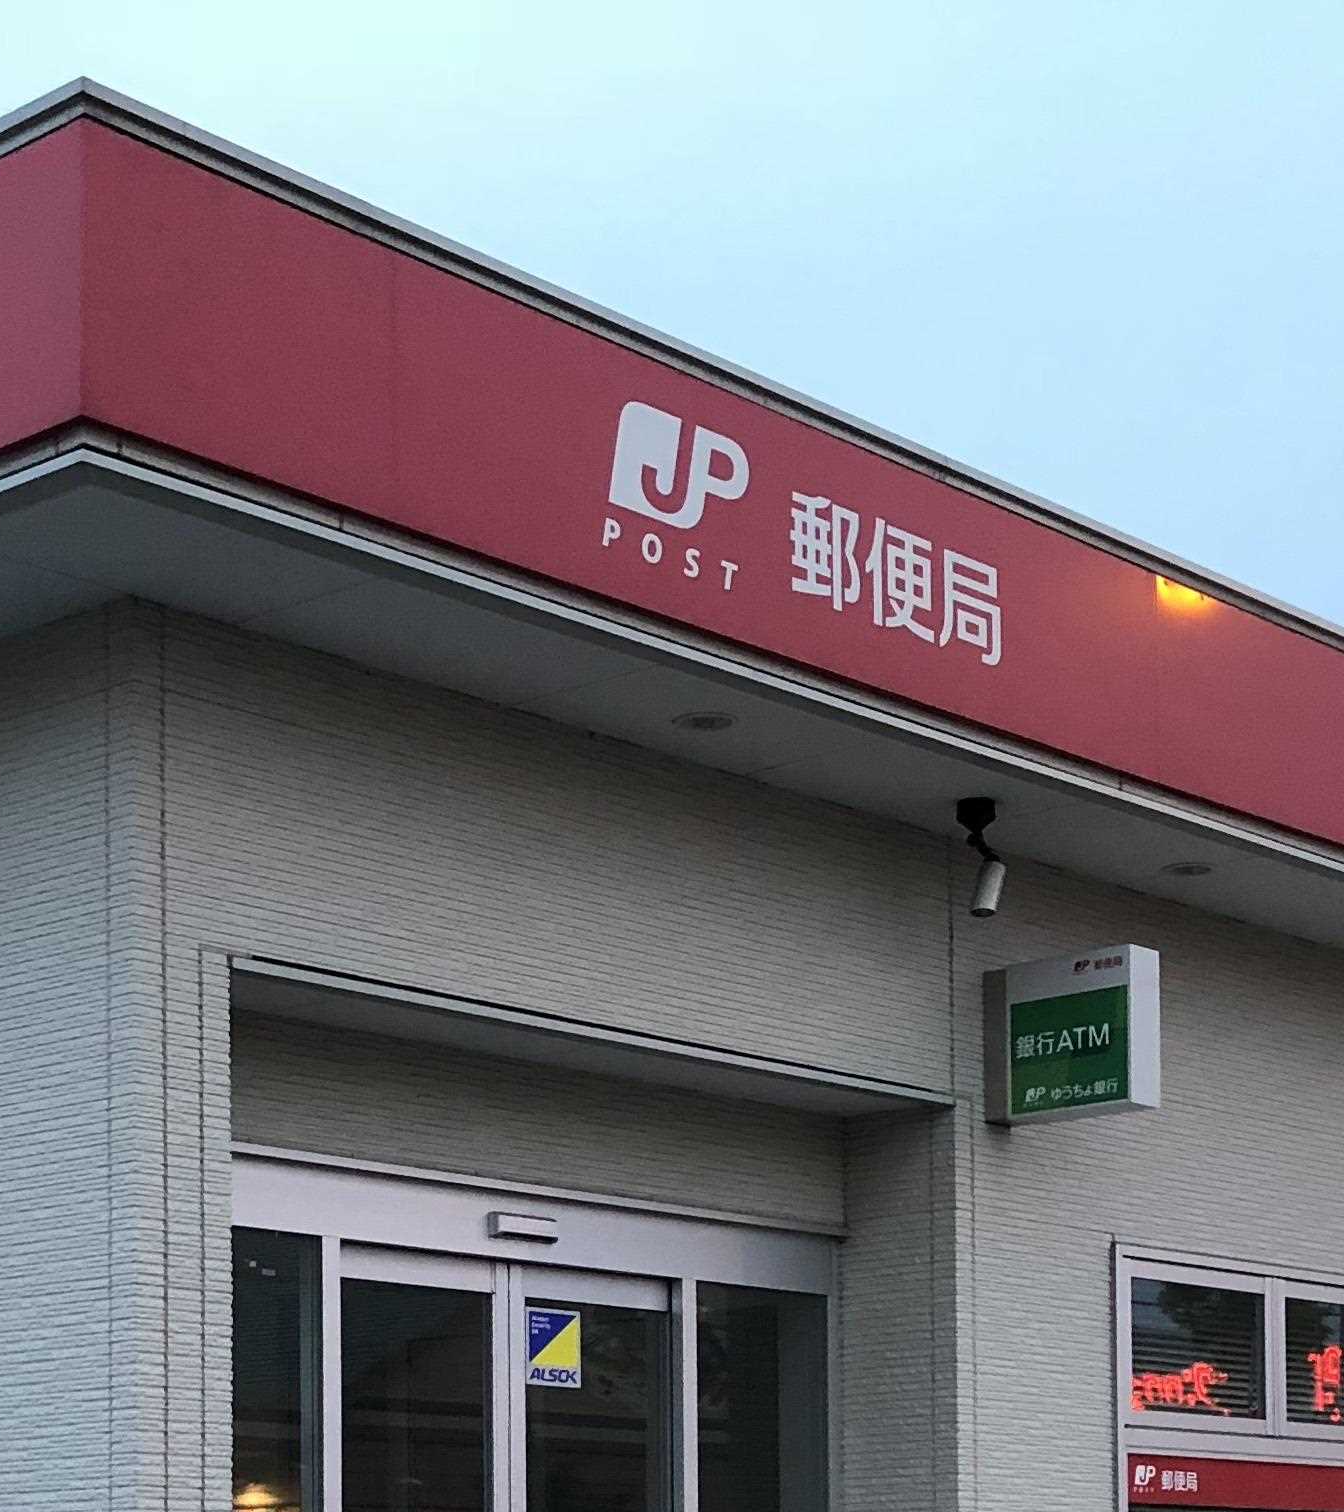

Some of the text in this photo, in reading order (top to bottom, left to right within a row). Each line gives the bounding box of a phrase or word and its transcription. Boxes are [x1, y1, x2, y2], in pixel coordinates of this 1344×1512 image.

[608, 401, 1002, 666] JP 郵便局
[602, 518, 739, 591] POST
[1015, 1022, 1110, 1059] 銀行ATM
[1051, 1078, 1118, 1100] ゆうちょ銀行
[1161, 1470, 1198, 1492] 郵便局
